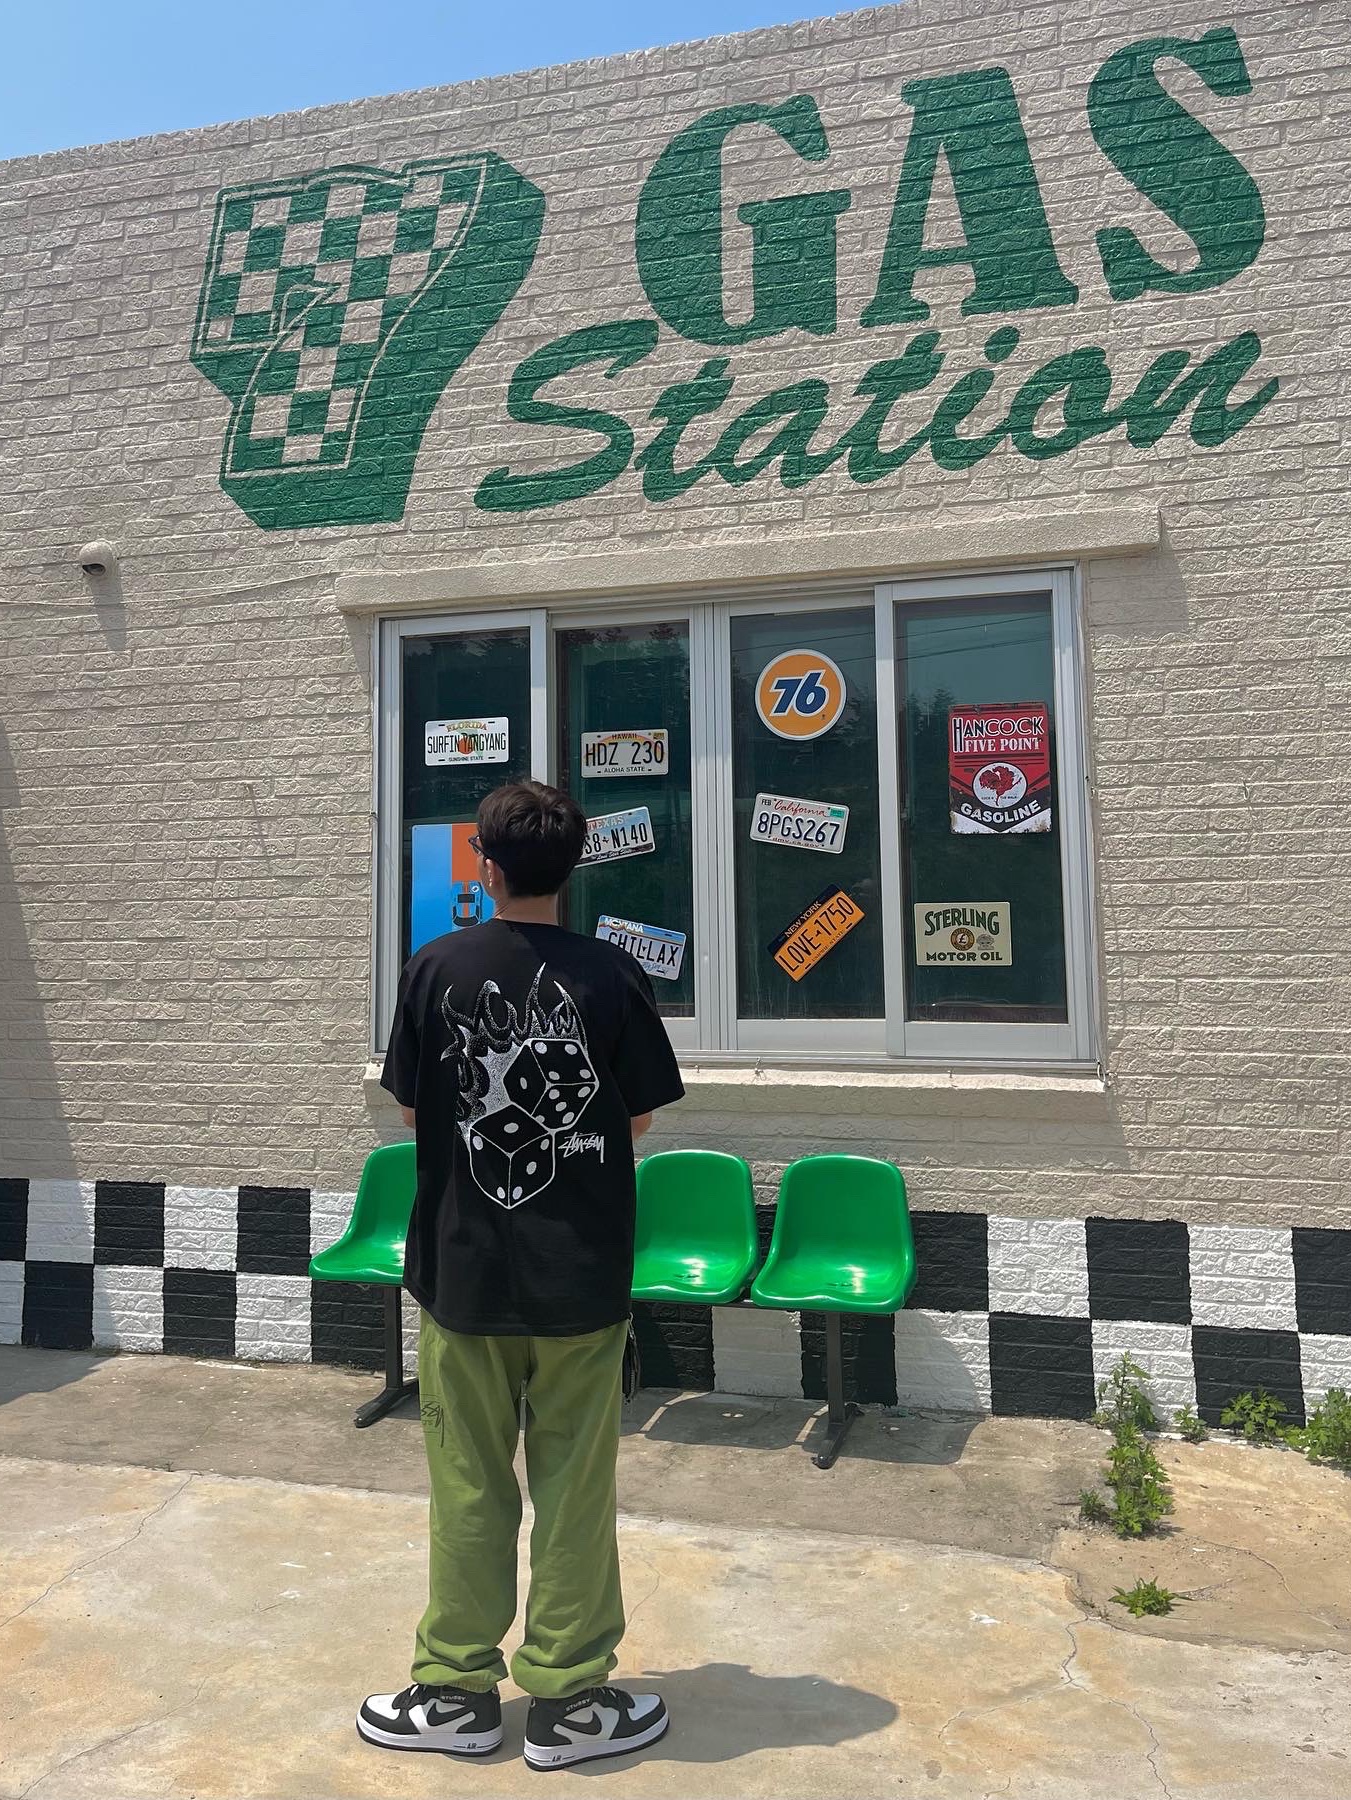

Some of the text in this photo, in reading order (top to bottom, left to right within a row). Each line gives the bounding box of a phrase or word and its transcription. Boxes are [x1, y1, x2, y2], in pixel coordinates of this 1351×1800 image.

[637, 29, 1264, 344] GAS
[475, 320, 1278, 511] Station
[769, 669, 829, 717] 76
[446, 720, 487, 732] FLORIDA
[952, 716, 1044, 752] HANCOCK
[427, 732, 506, 754] SURFIN YANGYANG
[585, 740, 665, 766] HDZ 230
[965, 737, 1041, 752] FIVE POINT
[774, 800, 830, 817] California
[960, 799, 1041, 824] GASOLINE
[587, 815, 625, 830] TEXAS
[757, 812, 840, 845] 8PGS267
[584, 822, 648, 854] S8 N140
[604, 917, 644, 934] MONTANA
[784, 900, 822, 938] NEW YORK
[924, 908, 1000, 936] STERLING
[778, 896, 854, 972] LOVE 1750
[926, 952, 1003, 961] MOTOR OIL
